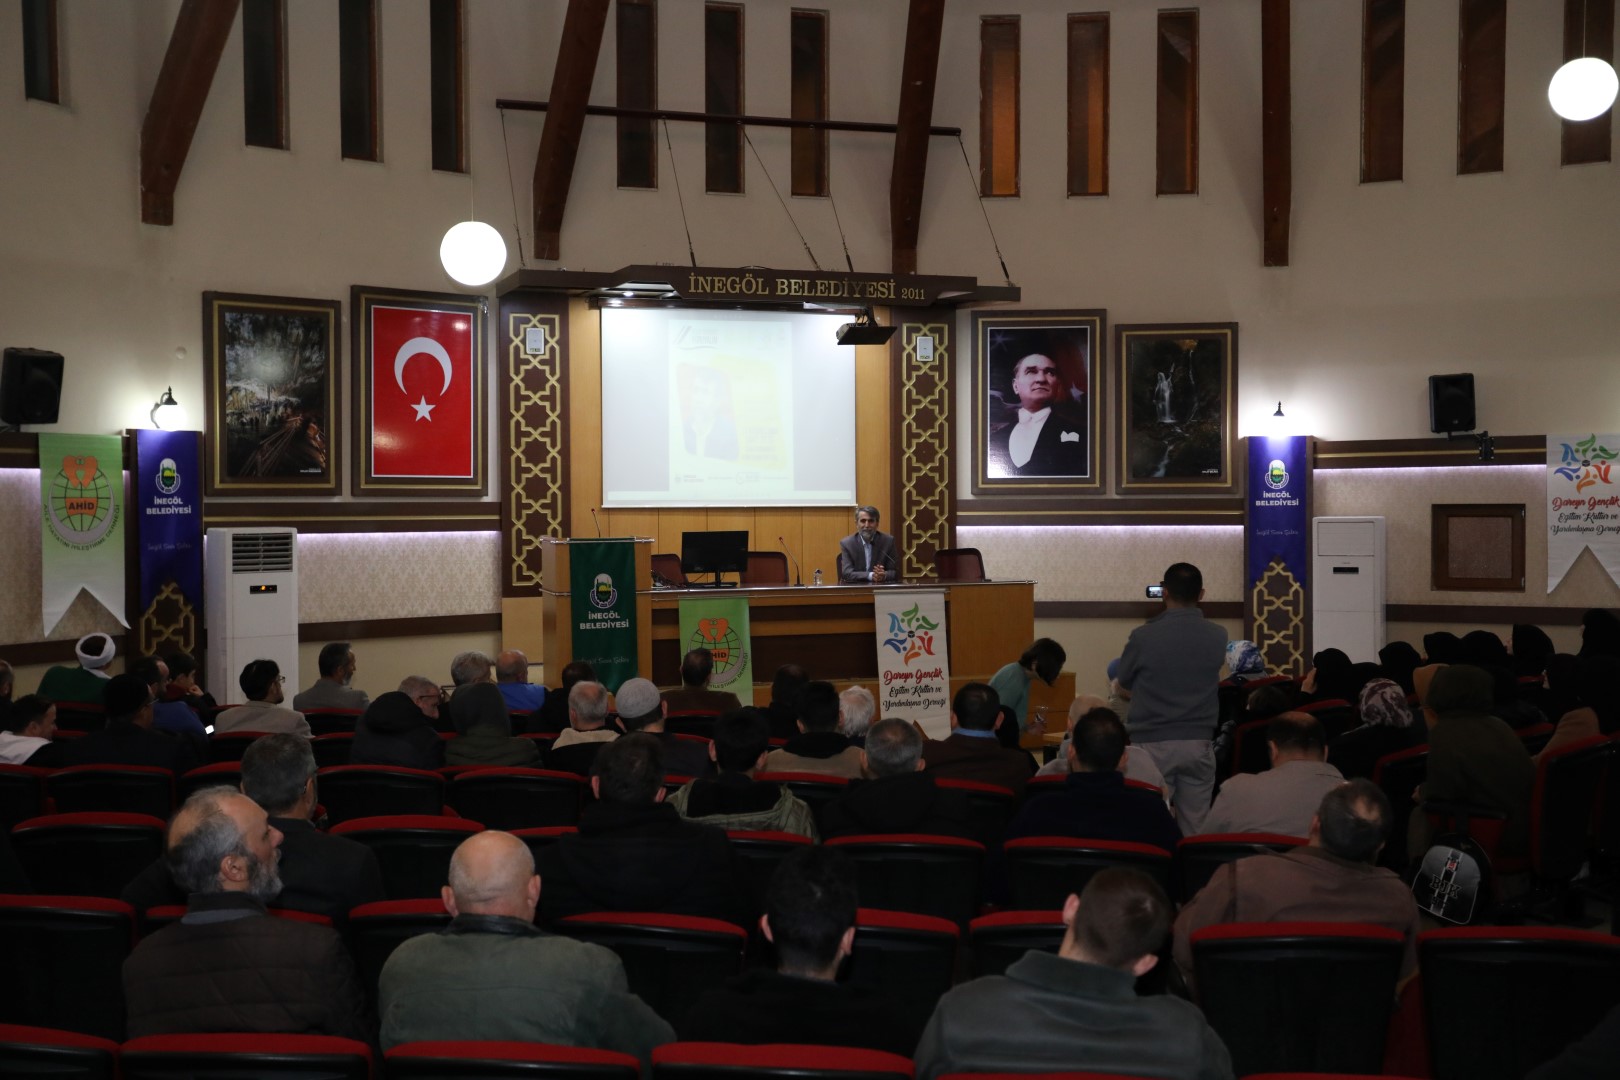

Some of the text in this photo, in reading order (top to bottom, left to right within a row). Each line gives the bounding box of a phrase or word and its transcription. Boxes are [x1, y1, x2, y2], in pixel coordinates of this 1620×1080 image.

[688, 272, 925, 300] İNEGÖL BELEDİYESİ 2011
[1263, 490, 1291, 498] İNEGÖL
[68, 500, 95, 510] AHİD
[154, 496, 183, 505] İNEGÖL
[1255, 498, 1299, 506] BELEDİYESİ
[1552, 496, 1586, 511] Dareyn
[146, 505, 192, 515] BELEDİYESİ
[588, 610, 621, 620] İNEGÖL
[580, 619, 629, 630] BELEDİYESİ
[711, 651, 727, 659] HİD
[883, 667, 944, 685] Dareyn Gençlik
